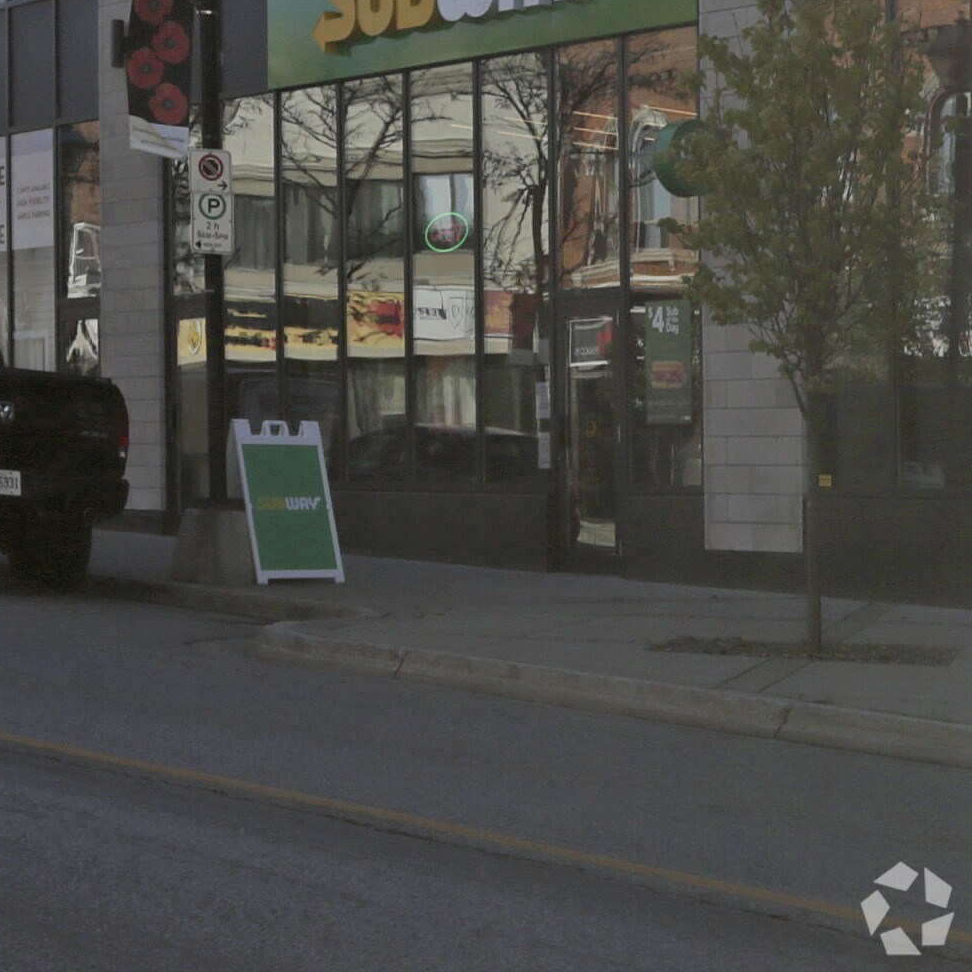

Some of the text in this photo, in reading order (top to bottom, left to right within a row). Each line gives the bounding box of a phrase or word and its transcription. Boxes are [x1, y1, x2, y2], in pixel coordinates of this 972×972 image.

[666, 306, 679, 316] Sub
[666, 323, 679, 334] Day
[256, 496, 321, 512] SUBWAY
